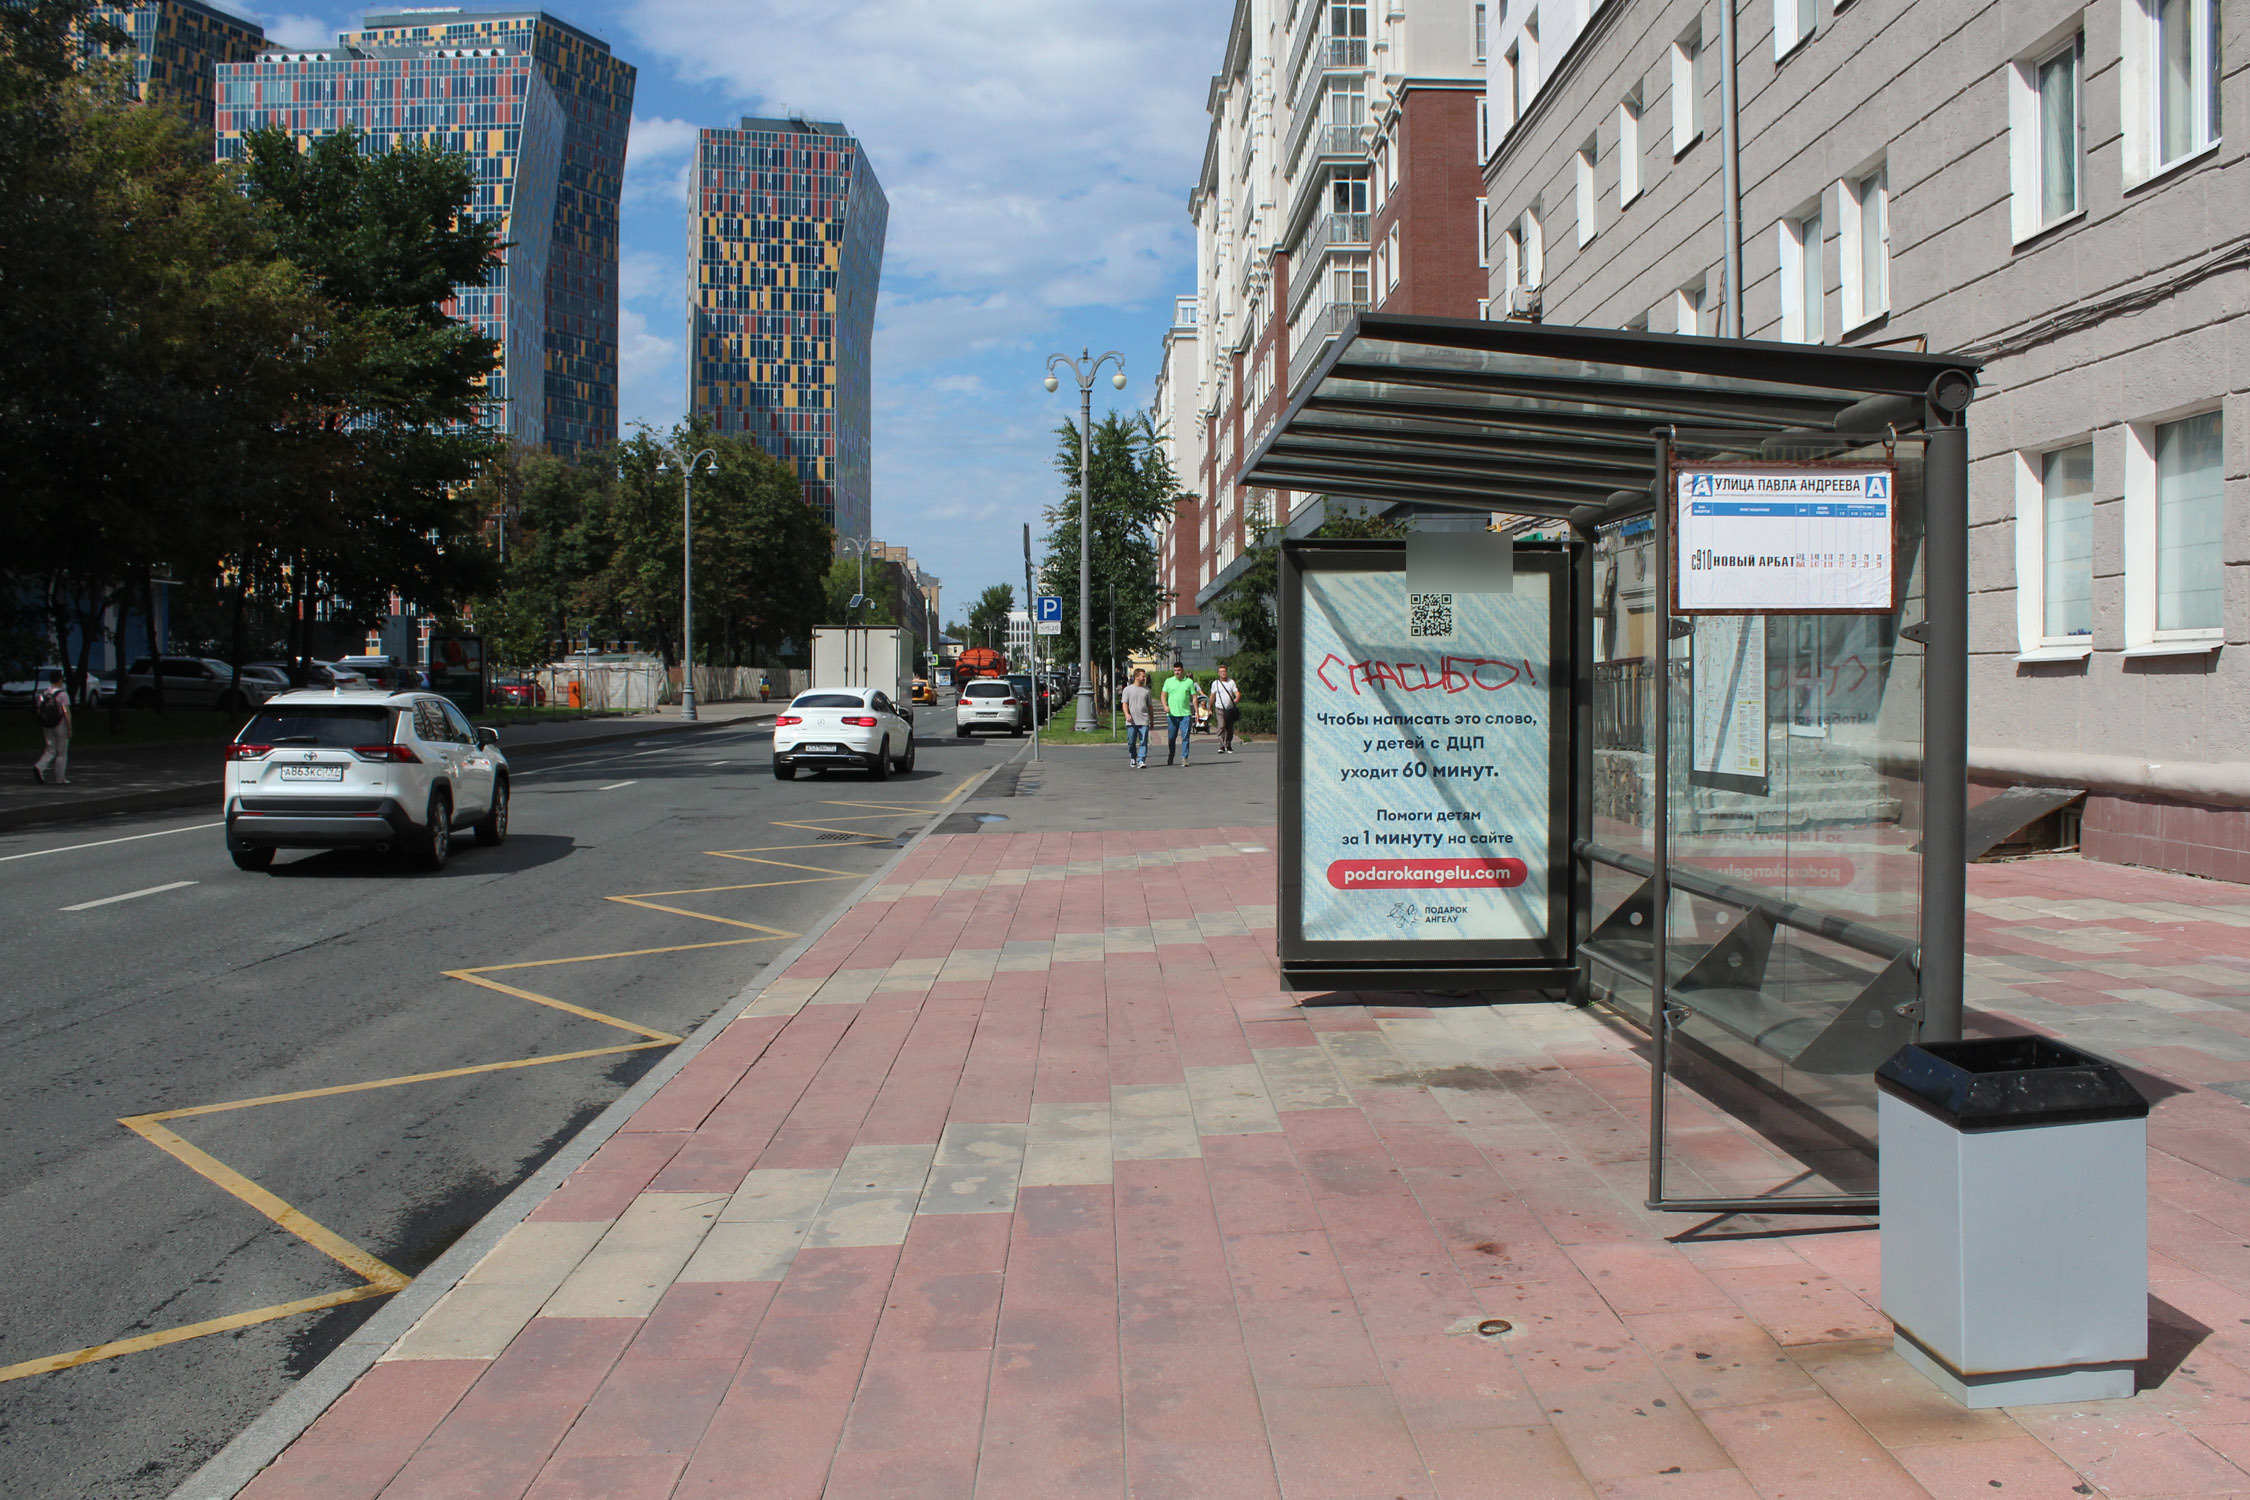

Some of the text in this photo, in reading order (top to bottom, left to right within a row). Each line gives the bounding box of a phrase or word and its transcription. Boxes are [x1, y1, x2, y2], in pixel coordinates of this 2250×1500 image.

[1692, 476, 1712, 495] А
[1715, 479, 1754, 493] УЛИЦА
[1758, 479, 1796, 491] ПАВЛА
[1800, 479, 1860, 493] АНДРЕЕВА
[1867, 478, 1885, 497] А
[1691, 549, 1712, 570] с910
[1713, 554, 1795, 567] НОВЫЙ АРБАТ
[1043, 599, 1058, 619] P
[1317, 653, 1537, 695] СПАСИБО!
[1317, 712, 1537, 726] Чтобы написать это слово,
[1363, 736, 1484, 753] у детей с ДЦП
[284, 767, 322, 776] А863КС
[1340, 762, 1499, 781] уходит 60 минут.
[1377, 809, 1480, 823] Помоги детям
[1342, 830, 1513, 848] за 1 минуту на сайте
[1344, 865, 1511, 884] podarokangelu.com
[1425, 906, 1468, 915] ПОДАРОК
[1425, 915, 1459, 923] АНГЕЛУ
